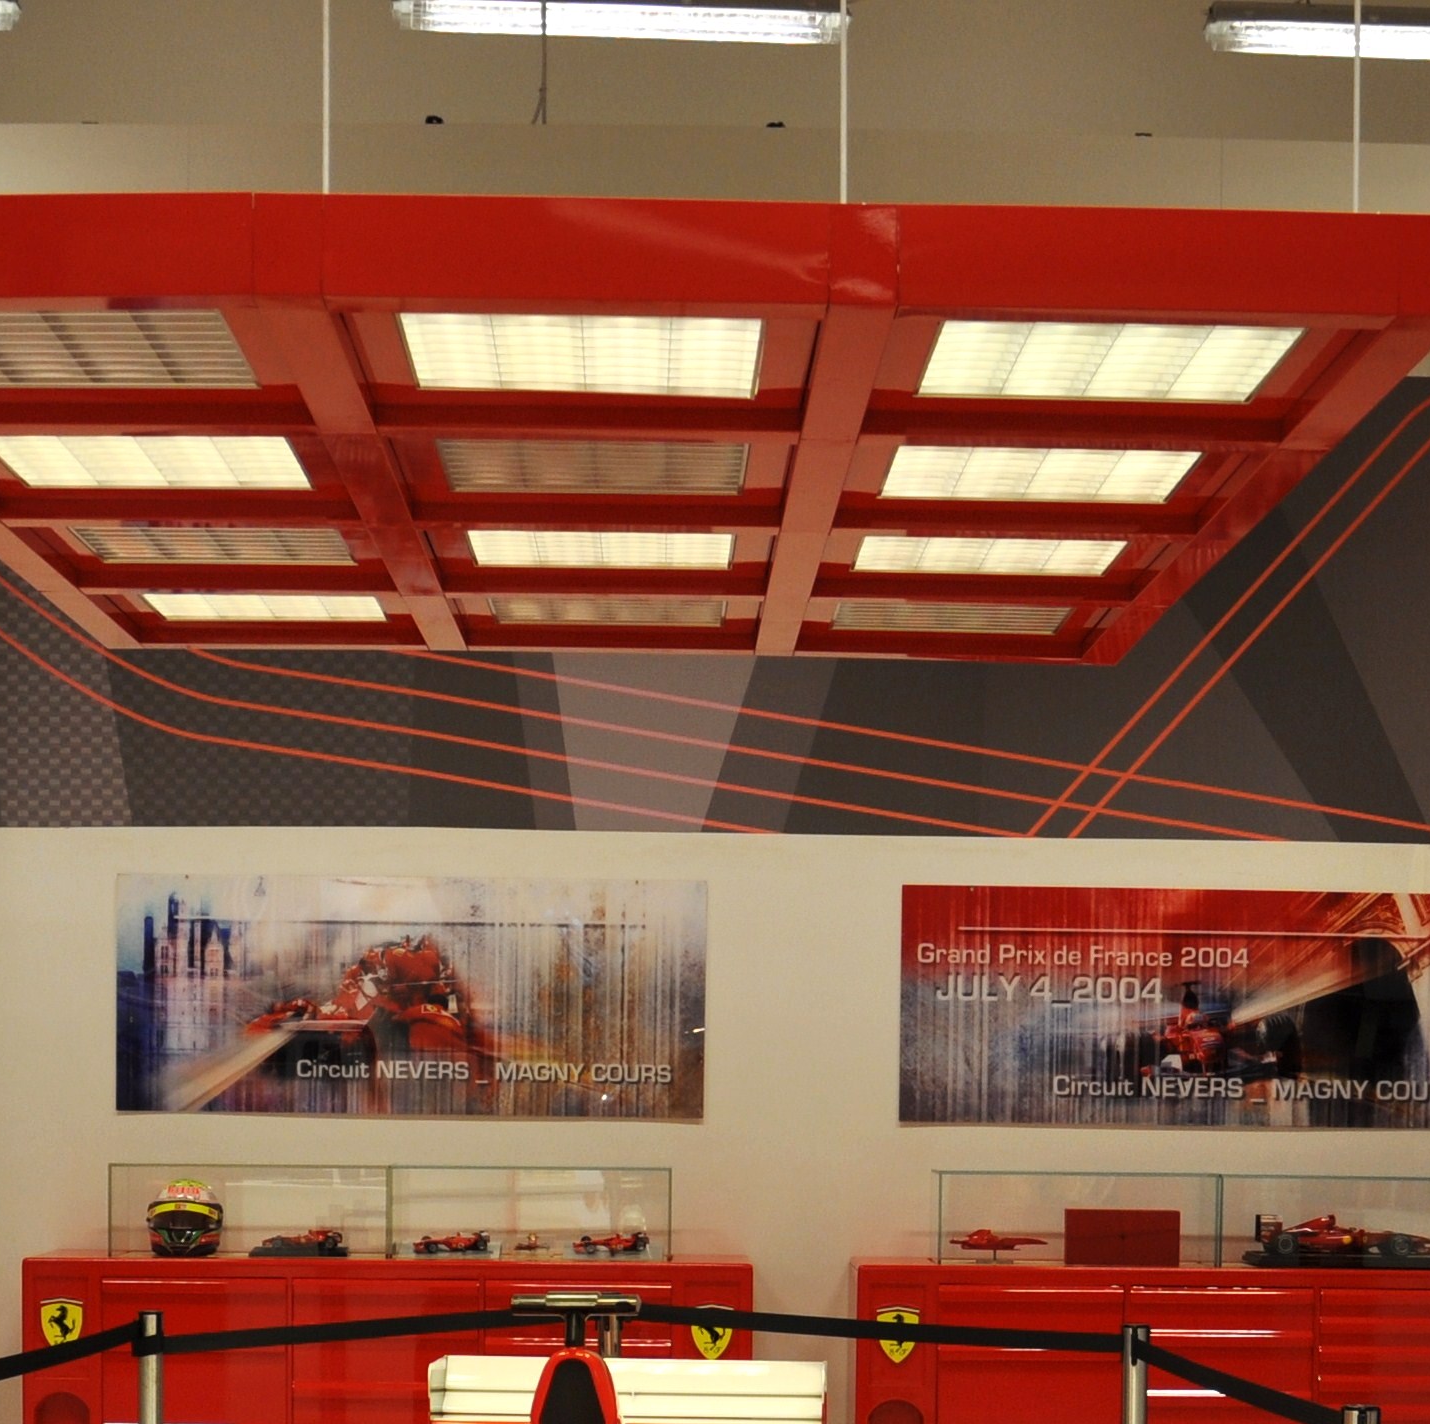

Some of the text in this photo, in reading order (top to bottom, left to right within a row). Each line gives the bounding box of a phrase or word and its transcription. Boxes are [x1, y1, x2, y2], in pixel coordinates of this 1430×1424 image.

[916, 943, 1249, 968] Grand Prix de France 2004
[936, 974, 1021, 1001] JULY
[296, 1059, 369, 1079] Circuit
[376, 1060, 469, 1080] NEVERS
[495, 1062, 583, 1082] MAGNY
[591, 1062, 672, 1083] COURS
[1053, 1075, 1133, 1097] Circuit
[1141, 1077, 1243, 1098] NEVERS
[1273, 1079, 1369, 1100] MAGNY
